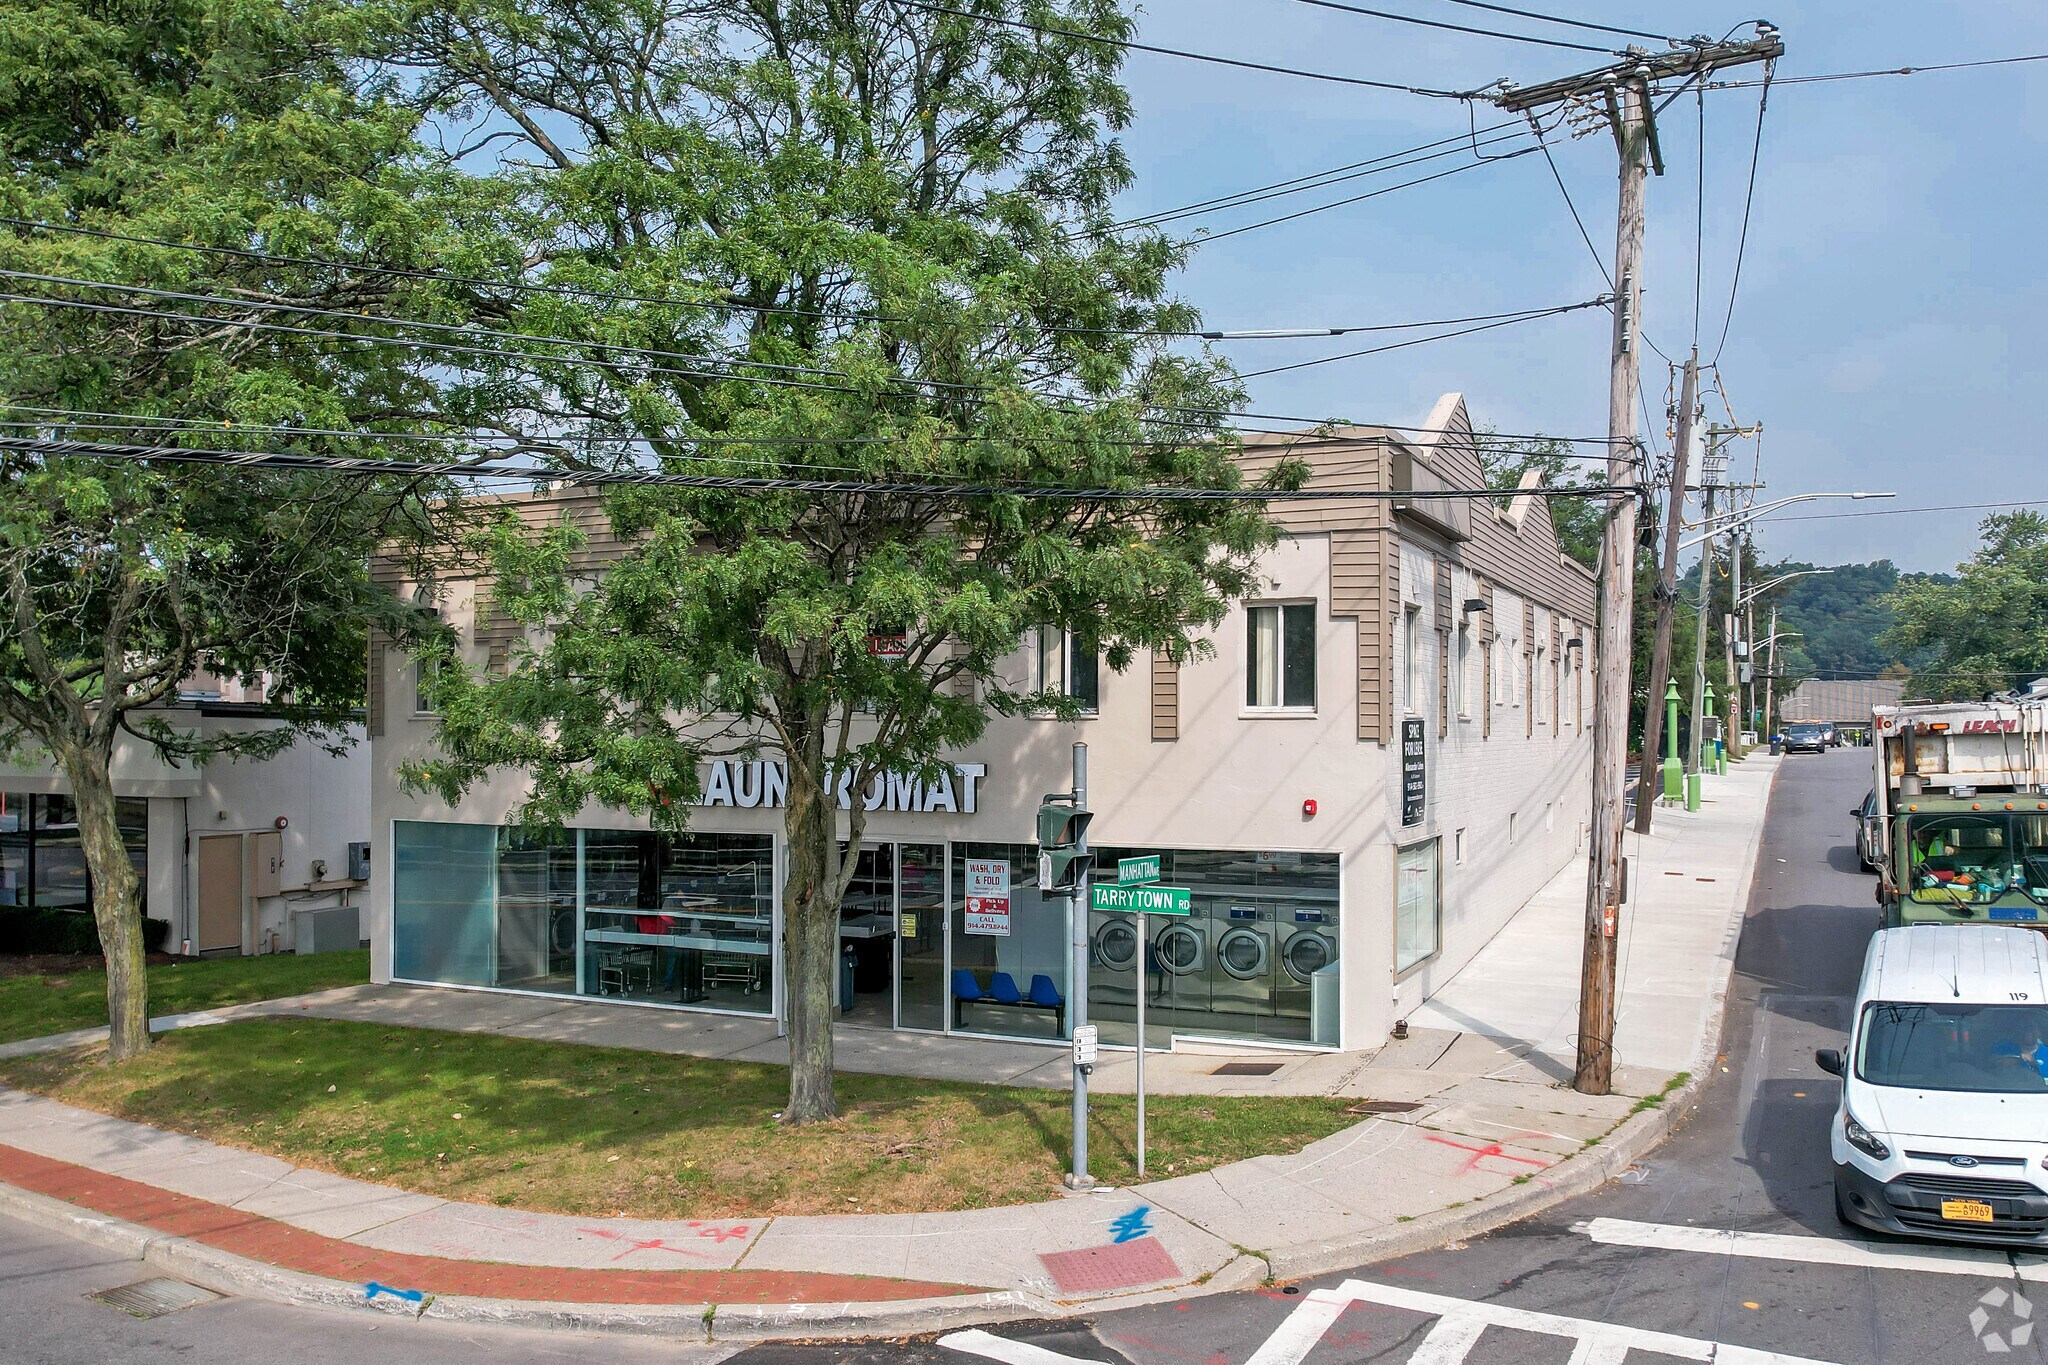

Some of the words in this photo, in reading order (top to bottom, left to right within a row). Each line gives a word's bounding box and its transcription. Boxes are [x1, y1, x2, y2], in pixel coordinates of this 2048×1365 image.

[1963, 719, 2016, 733] LEACH
[970, 864, 990, 874] WASH,
[993, 865, 1006, 873] DRY
[1120, 861, 1155, 881] MANHATTAN
[976, 876, 981, 884] &
[984, 876, 1000, 885] FOLD
[1095, 888, 1173, 909] TARRYTOWN
[1178, 900, 1190, 910] RD
[2009, 992, 2028, 1001] 119
